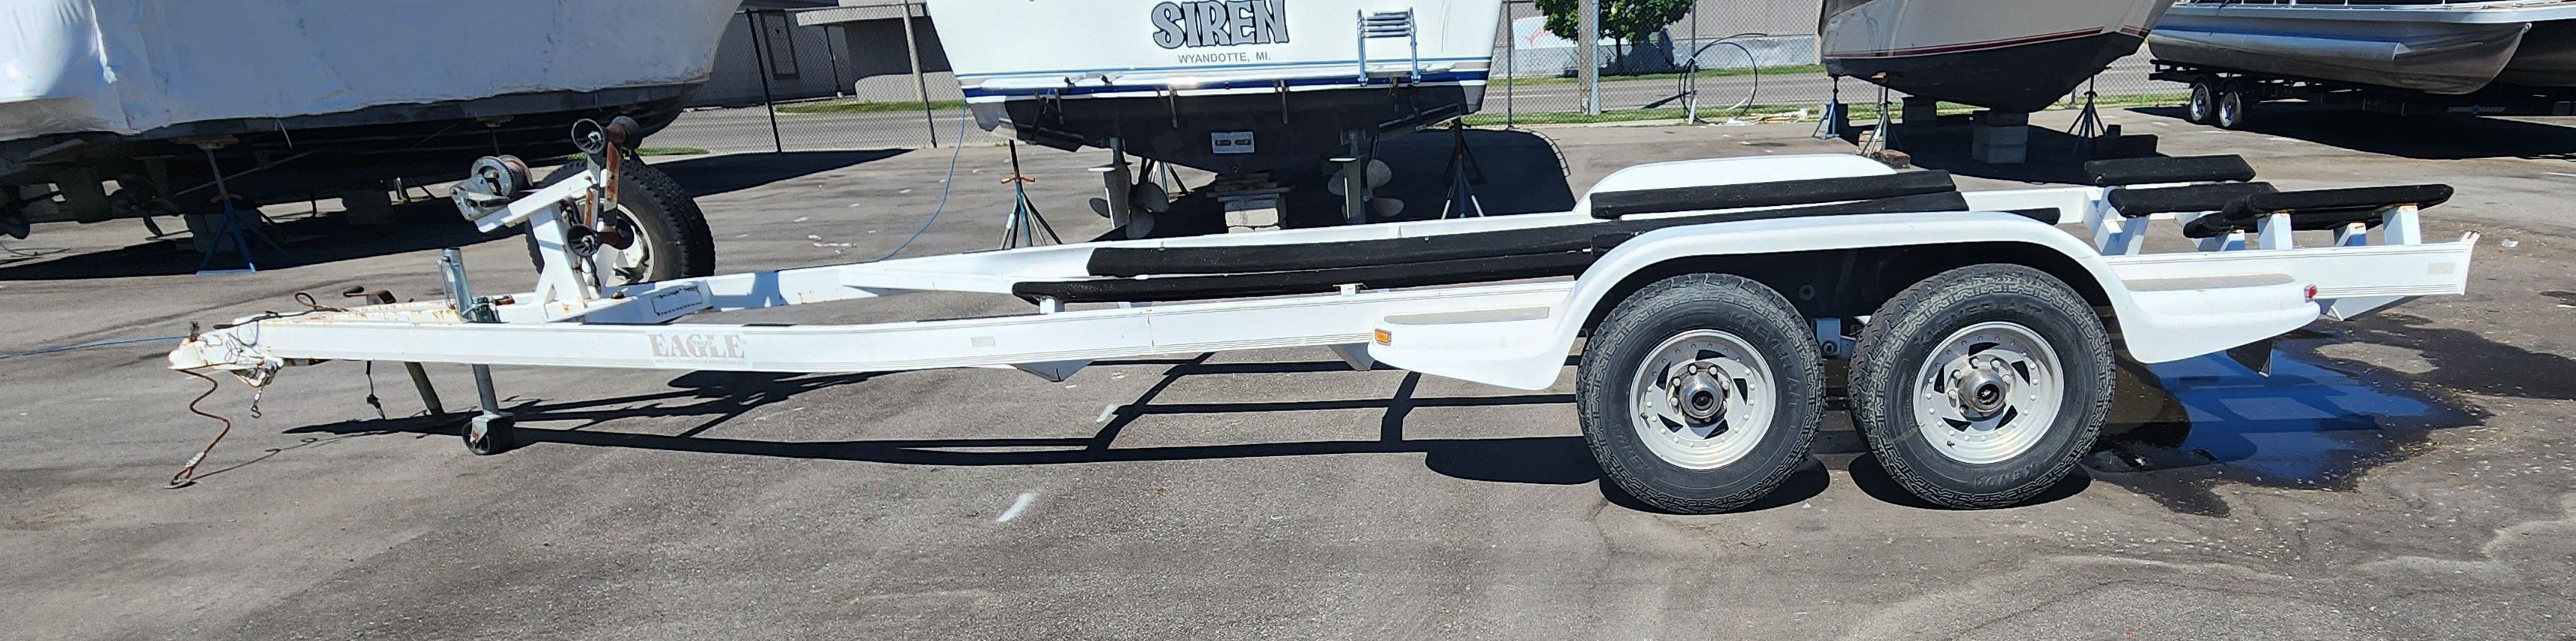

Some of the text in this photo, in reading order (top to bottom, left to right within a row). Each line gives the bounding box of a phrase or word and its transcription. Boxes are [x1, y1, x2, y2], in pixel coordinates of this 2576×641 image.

[1152, 0, 1290, 49] SIREN
[1178, 52, 1271, 64] WYANDOTTE, MI.
[647, 334, 746, 359] EAGLE
